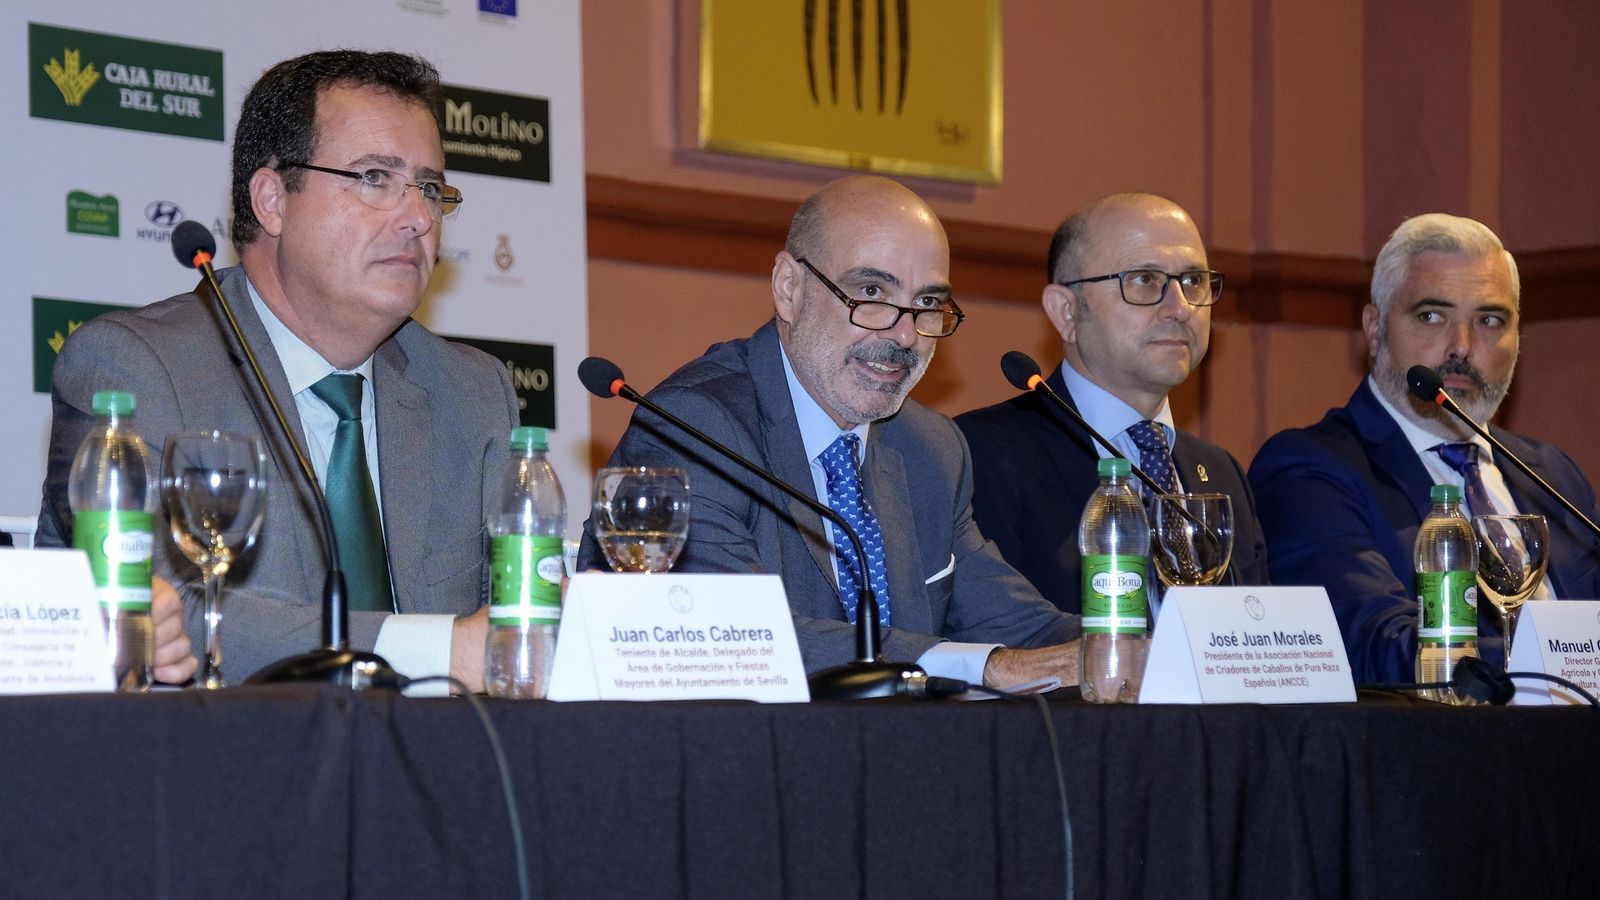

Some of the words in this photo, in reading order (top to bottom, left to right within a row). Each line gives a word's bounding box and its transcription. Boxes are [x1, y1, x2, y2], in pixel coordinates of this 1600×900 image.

[104, 62, 149, 87] CAJA
[153, 69, 215, 97] RURAL
[119, 88, 159, 113] DEL
[162, 95, 202, 119] SUR
[1093, 576, 1141, 588] aquBona
[26, 603, 81, 624] López
[609, 626, 648, 643] Juan
[653, 626, 705, 643] Carlos
[710, 625, 774, 642] Cabrera
[1209, 631, 1239, 647] José
[1242, 631, 1272, 647] Juan
[1275, 630, 1323, 647] Morales
[1548, 638, 1594, 653] Manuel
[616, 647, 657, 658] Teniente
[659, 647, 671, 657] de
[714, 646, 757, 659] Delegado
[760, 646, 774, 656] del
[1204, 651, 1243, 661] Presidente
[1245, 651, 1253, 660] de
[1255, 651, 1262, 660] la
[1264, 649, 1302, 660] Asociación
[1303, 649, 1334, 659] Nacional
[627, 661, 649, 672] Área
[652, 663, 663, 672] de
[666, 662, 725, 673] Gobernación
[736, 661, 769, 672] Fiestas
[1564, 656, 1592, 666] Director
[1205, 665, 1214, 675] de
[1216, 665, 1250, 675] Criadores
[1252, 664, 1261, 674] de
[1262, 664, 1293, 674] Caballos
[1295, 663, 1304, 673] de
[1305, 663, 1321, 673] Pura
[1323, 662, 1340, 672] Raza
[1592, 670, 1597, 679] y
[614, 678, 656, 690] Mayores
[659, 678, 673, 688] del
[676, 677, 740, 690] Ayuntamiento
[744, 676, 755, 687] de
[757, 676, 788, 687] Sevilla
[1244, 678, 1276, 689] Española
[1278, 677, 1309, 689] (ANCCE)
